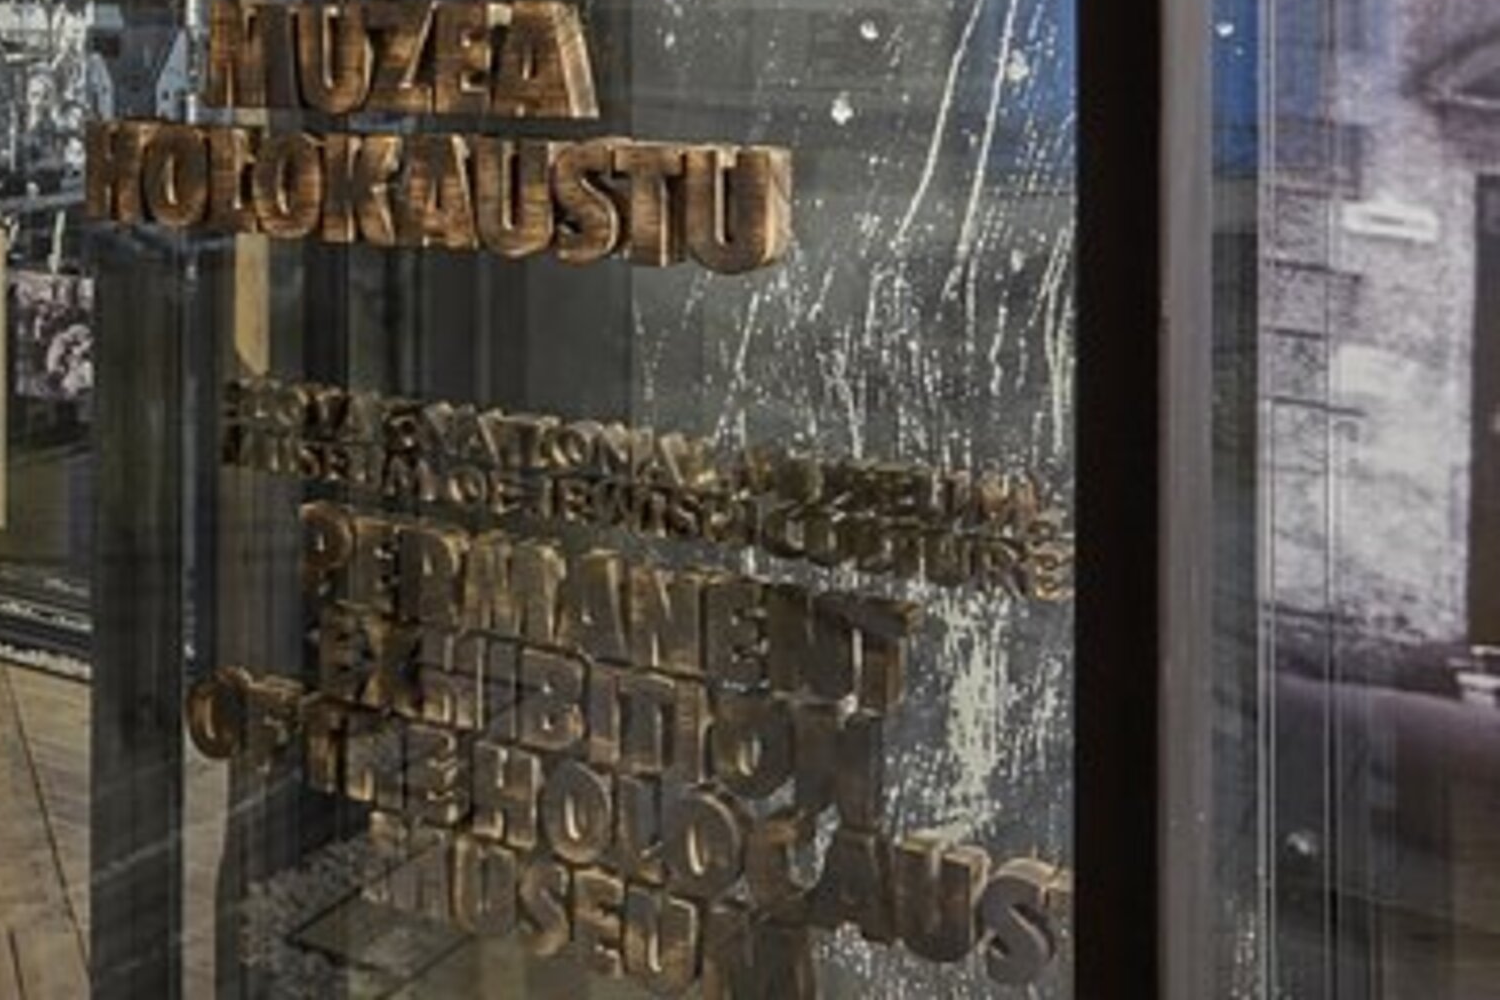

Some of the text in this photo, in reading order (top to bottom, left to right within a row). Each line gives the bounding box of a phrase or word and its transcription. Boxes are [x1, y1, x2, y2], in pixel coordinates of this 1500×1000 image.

[86, 116, 794, 274] HOLOKAUSTU
[300, 500, 924, 716] PERMANENT
[312, 600, 888, 832] EXHIBITION
[470, 736, 1074, 988] HOLOCAUS
